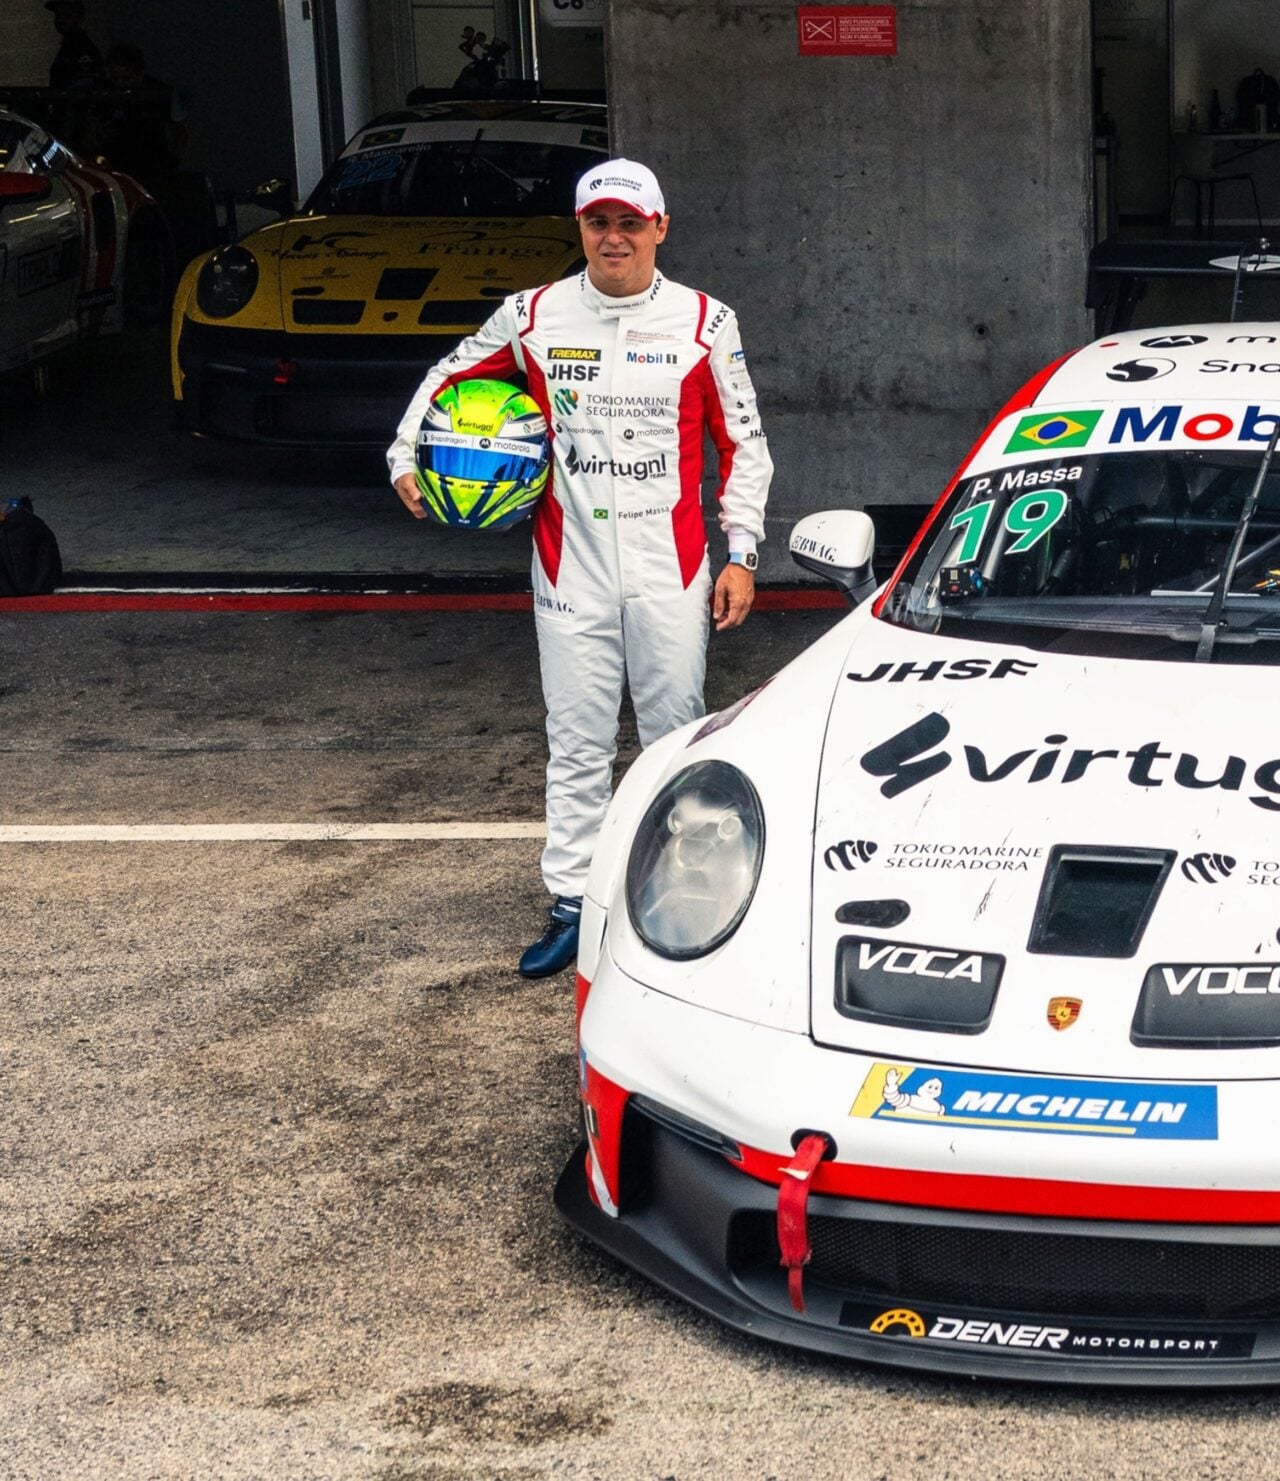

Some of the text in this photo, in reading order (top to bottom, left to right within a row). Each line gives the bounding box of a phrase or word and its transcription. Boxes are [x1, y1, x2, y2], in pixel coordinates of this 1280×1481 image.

[707, 305, 730, 336] HRX
[551, 348, 598, 360] FREMAX
[626, 351, 663, 364] Mobil
[547, 364, 601, 382] JHSF
[586, 394, 671, 407] TOKIO MARINE
[586, 406, 666, 418] SEGURADORA
[636, 426, 675, 437] motorola
[430, 433, 531, 453] Snapdragon motorola
[579, 453, 667, 481] virtugnl
[970, 465, 1084, 498] P. Massa
[618, 506, 670, 520] Felipe Massa
[949, 488, 1069, 565] 19
[846, 658, 1039, 683] JHSF
[891, 843, 1044, 858] TOKIO MARINE
[884, 857, 1029, 871] SEGURADORA
[858, 943, 983, 983] VOCA
[952, 1089, 1188, 1123] MICHELIN
[928, 1315, 1219, 1351] DENER MOTORSPORT
